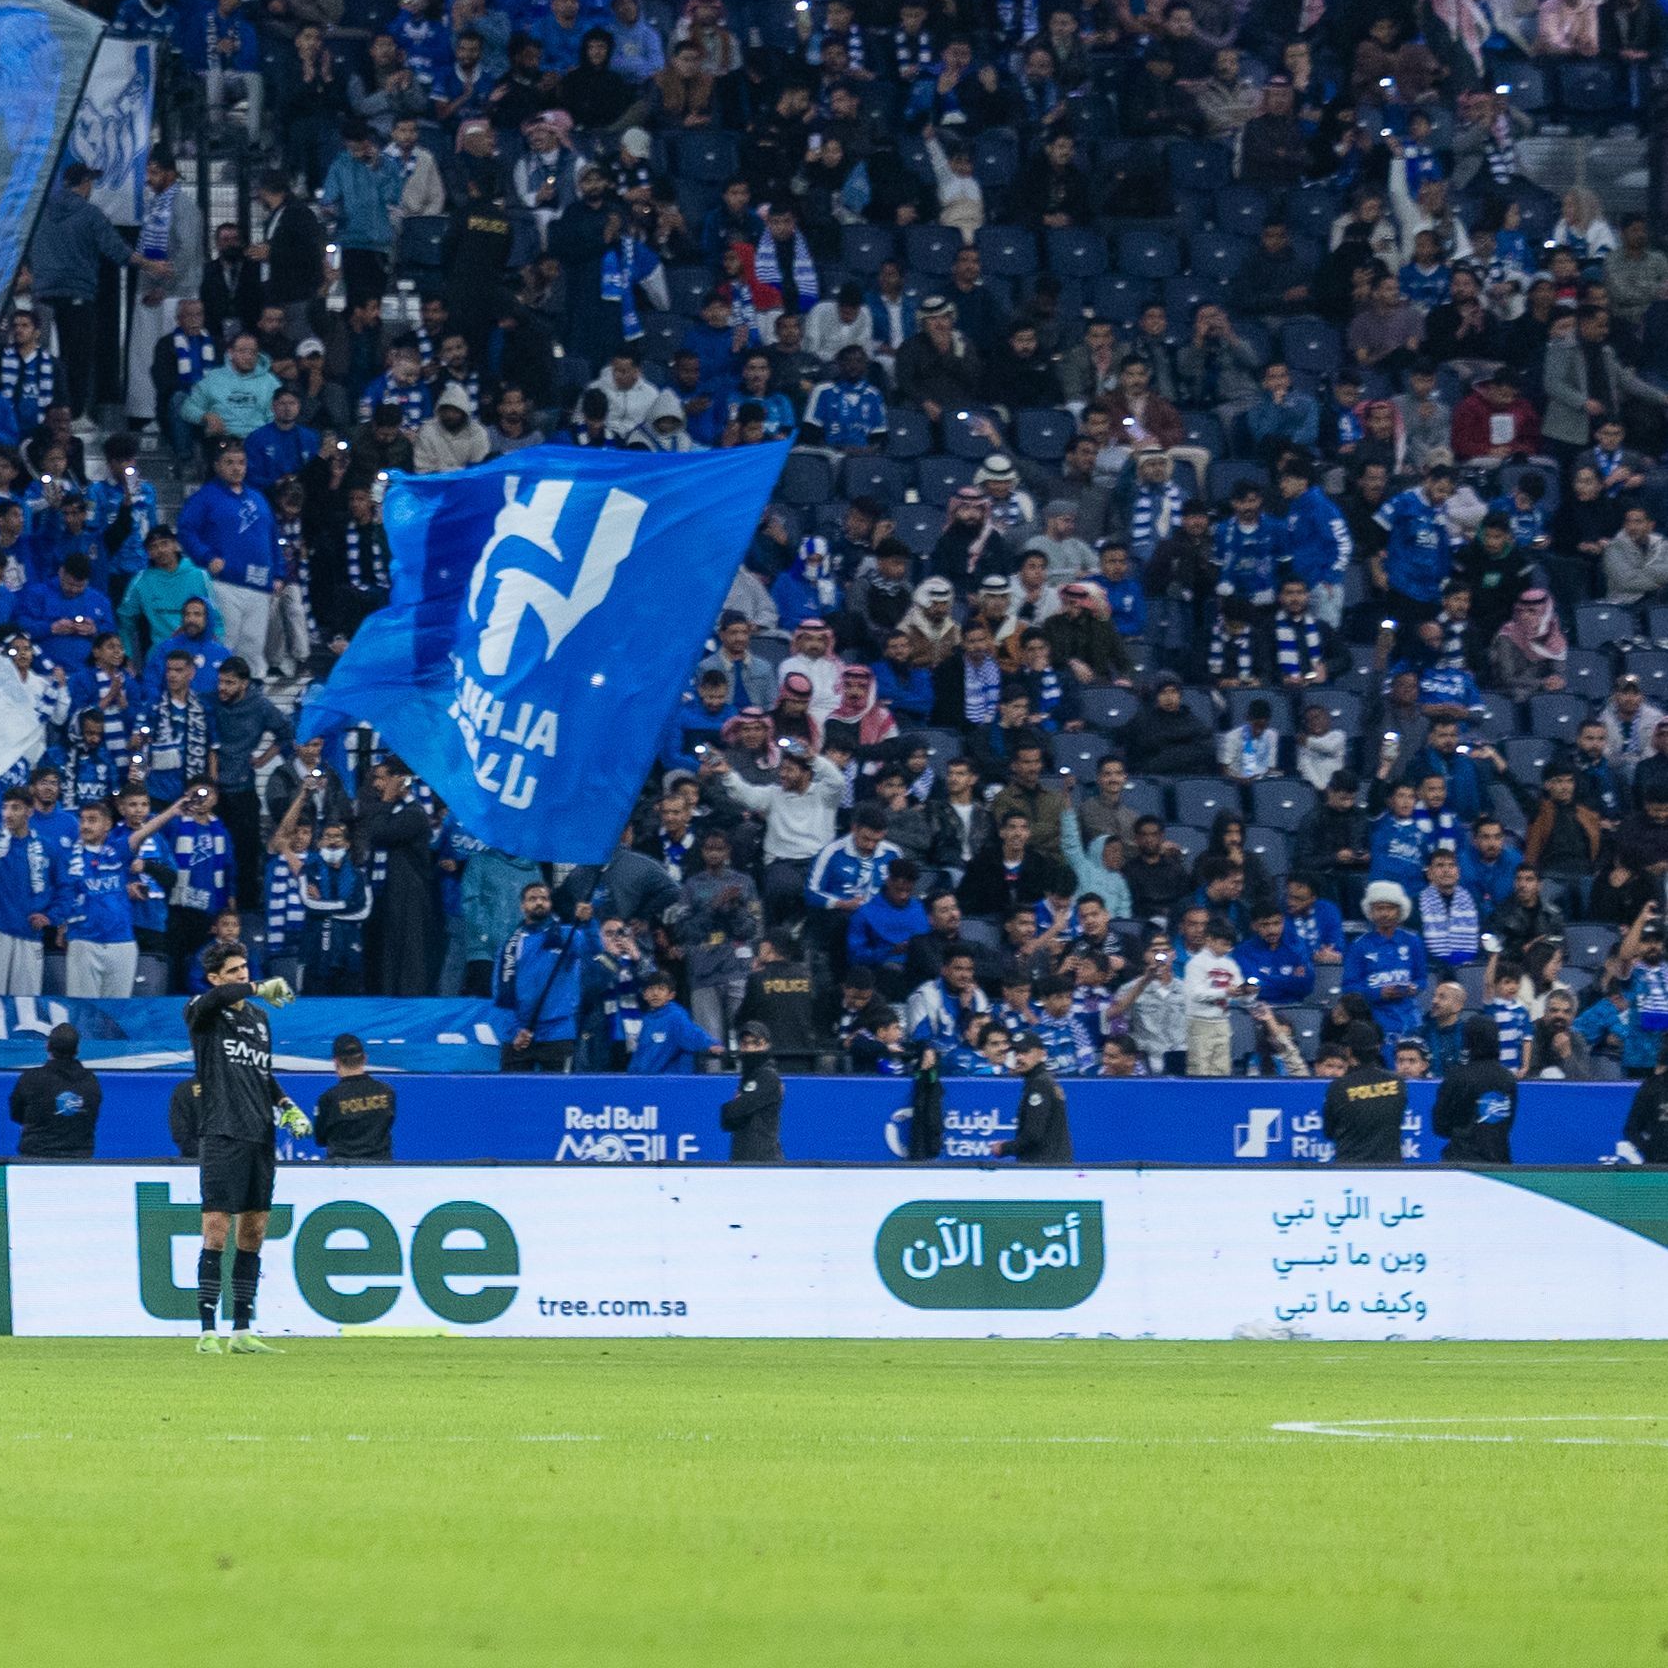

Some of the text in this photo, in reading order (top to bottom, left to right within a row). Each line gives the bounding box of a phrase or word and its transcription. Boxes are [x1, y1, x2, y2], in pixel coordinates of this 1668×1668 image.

[763, 978, 810, 993] POLICE
[1347, 1080, 1399, 1100] POLICE
[338, 1094, 389, 1114] POLICE
[565, 1106, 658, 1129] Red Bull
[1273, 1200, 1315, 1233] تبي
[1379, 1197, 1426, 1229] على
[1347, 1243, 1370, 1266] ما
[1380, 1249, 1427, 1273] وين
[538, 1296, 688, 1317] tree.com.sa
[1327, 1290, 1351, 1313] ما
[1360, 1291, 1427, 1321] وكيف
